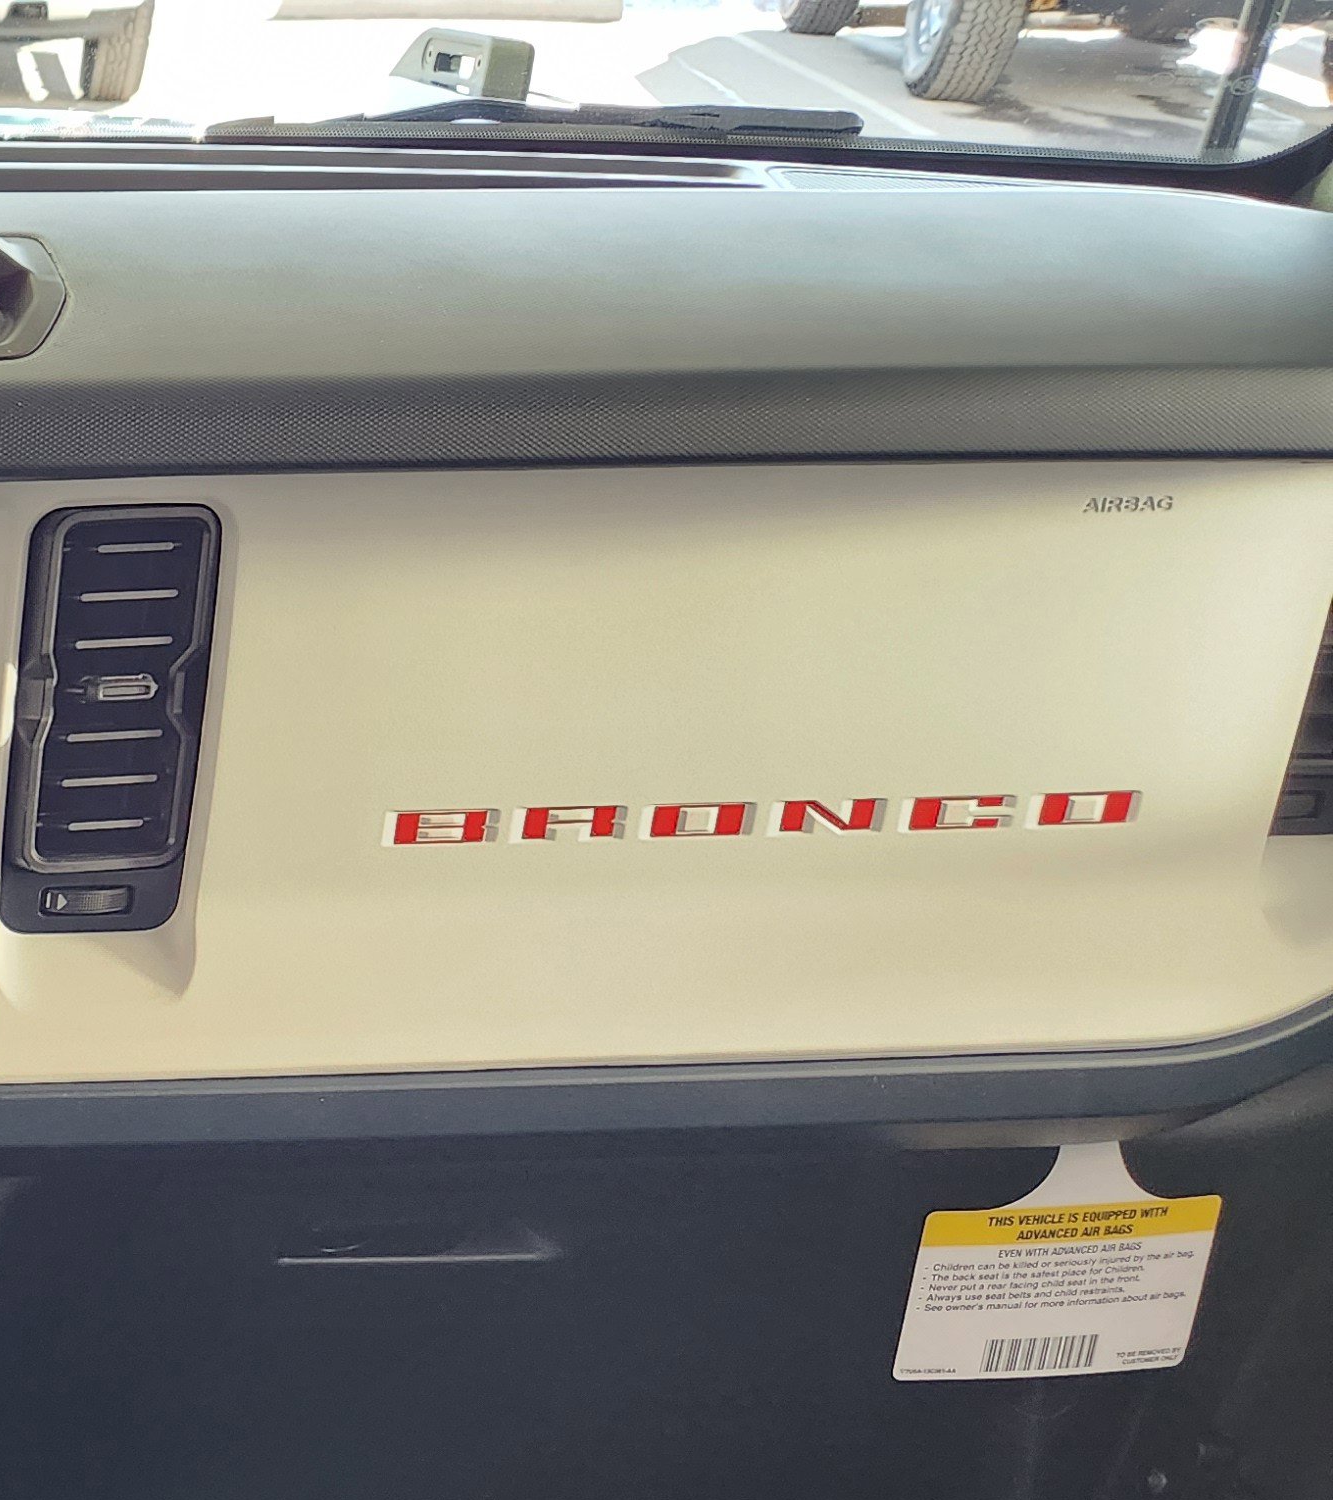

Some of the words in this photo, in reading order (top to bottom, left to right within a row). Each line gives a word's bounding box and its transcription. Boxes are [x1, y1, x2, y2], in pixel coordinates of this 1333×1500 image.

[1083, 495, 1174, 513] AIRBAG
[381, 788, 1143, 847] BRONCO
[988, 1216, 1015, 1227] THIS
[1018, 1213, 1064, 1226] VEHICLE
[1068, 1213, 1078, 1223] IS
[1083, 1209, 1137, 1222] EQUIPPED
[1140, 1206, 1169, 1218] WITH
[1017, 1228, 1078, 1240] ADVANCED
[1081, 1226, 1100, 1237] AIR
[1104, 1224, 1134, 1235] BAGS
[998, 1249, 1022, 1259] EVEN
[1025, 1248, 1049, 1257] WITH
[1051, 1245, 1098, 1256] ADVANCED
[1101, 1243, 1116, 1253] AIR
[1119, 1241, 1143, 1251] BAGS
